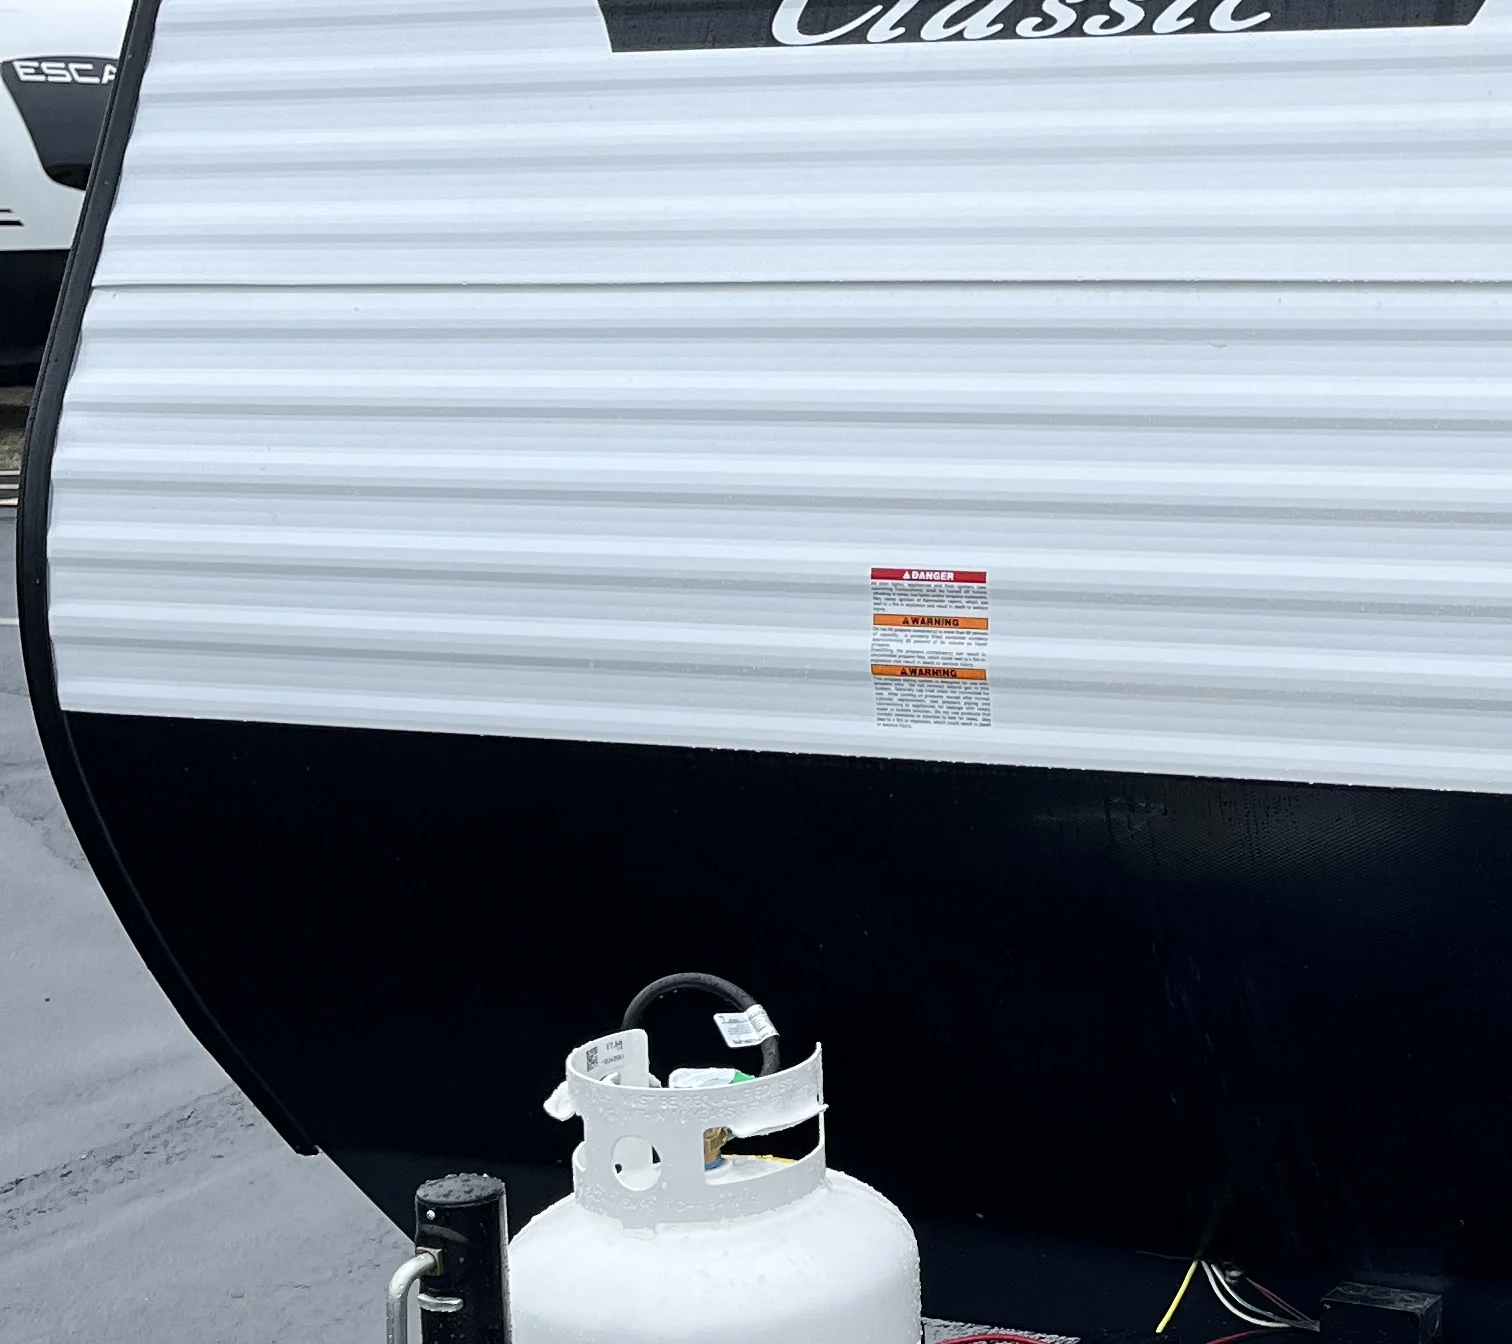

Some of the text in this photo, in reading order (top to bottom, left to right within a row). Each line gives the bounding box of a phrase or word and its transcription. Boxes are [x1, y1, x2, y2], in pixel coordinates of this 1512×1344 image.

[912, 570, 955, 582] DANGER
[910, 616, 960, 627] WARNING
[908, 667, 957, 678] WARNING
